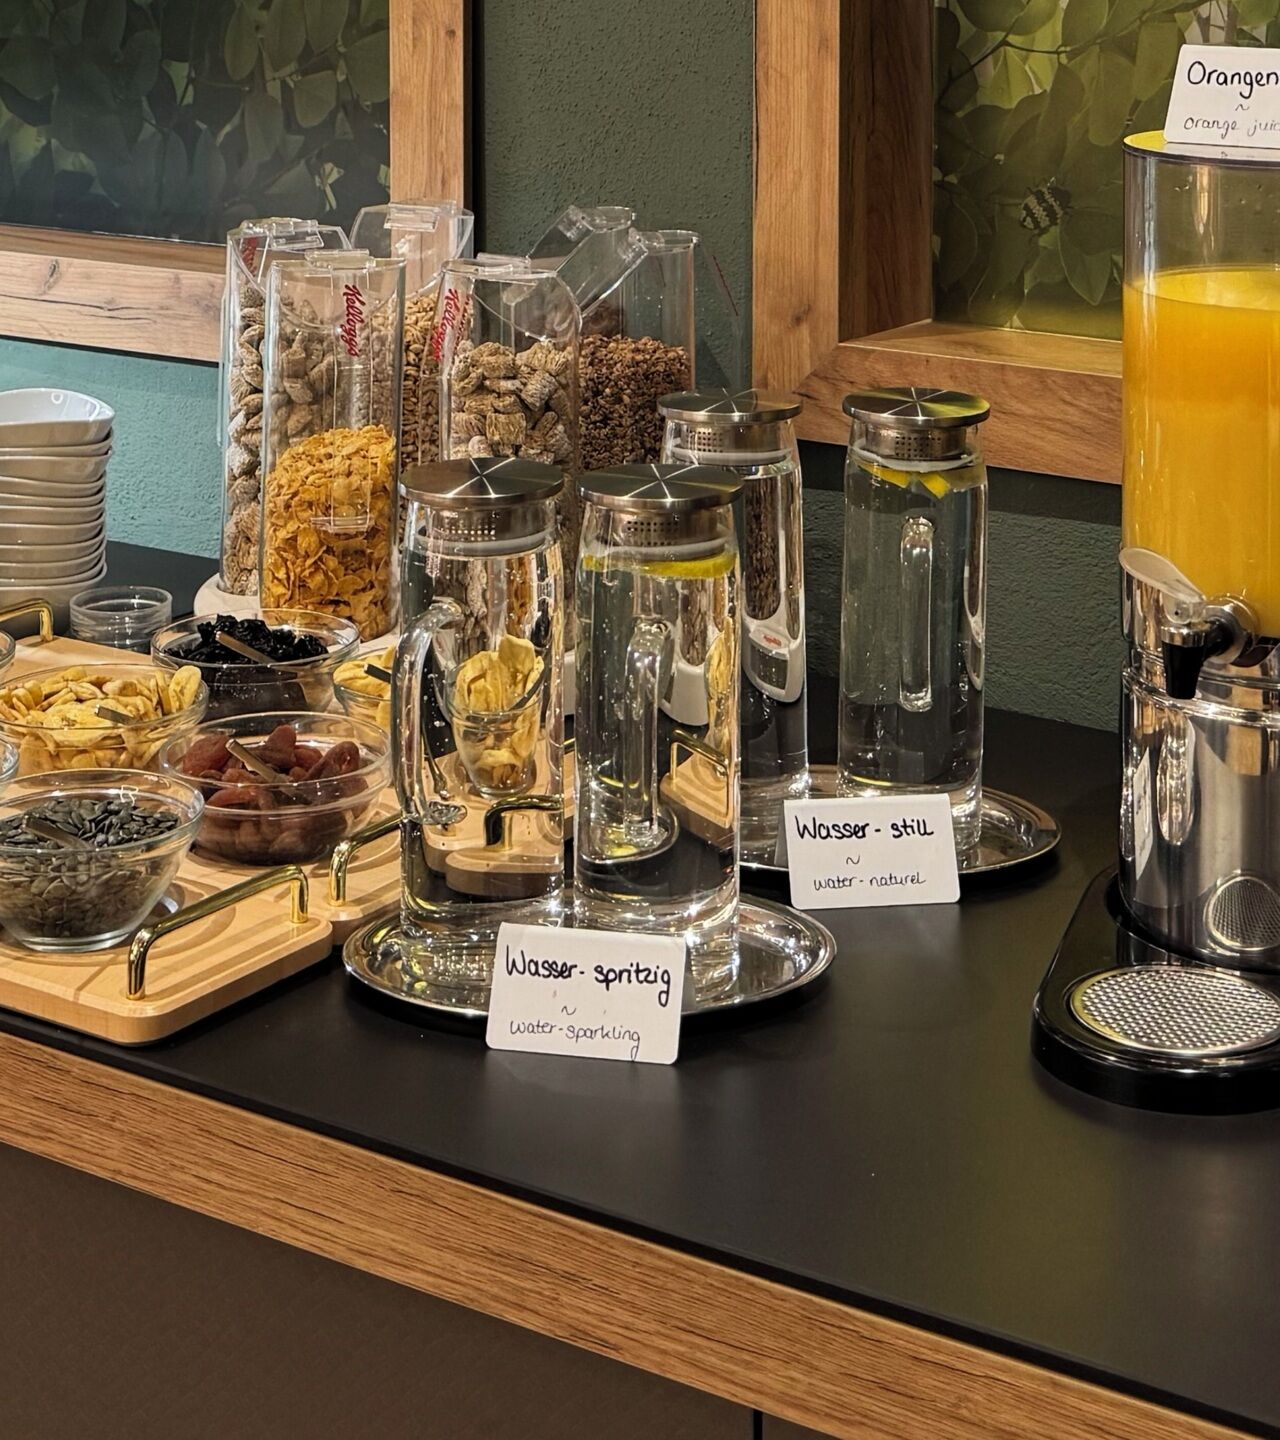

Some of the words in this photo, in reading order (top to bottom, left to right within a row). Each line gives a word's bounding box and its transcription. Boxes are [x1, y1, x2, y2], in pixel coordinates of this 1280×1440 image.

[1183, 116, 1238, 140] orange
[890, 817, 935, 839] still
[594, 962, 671, 1008] spritzig
